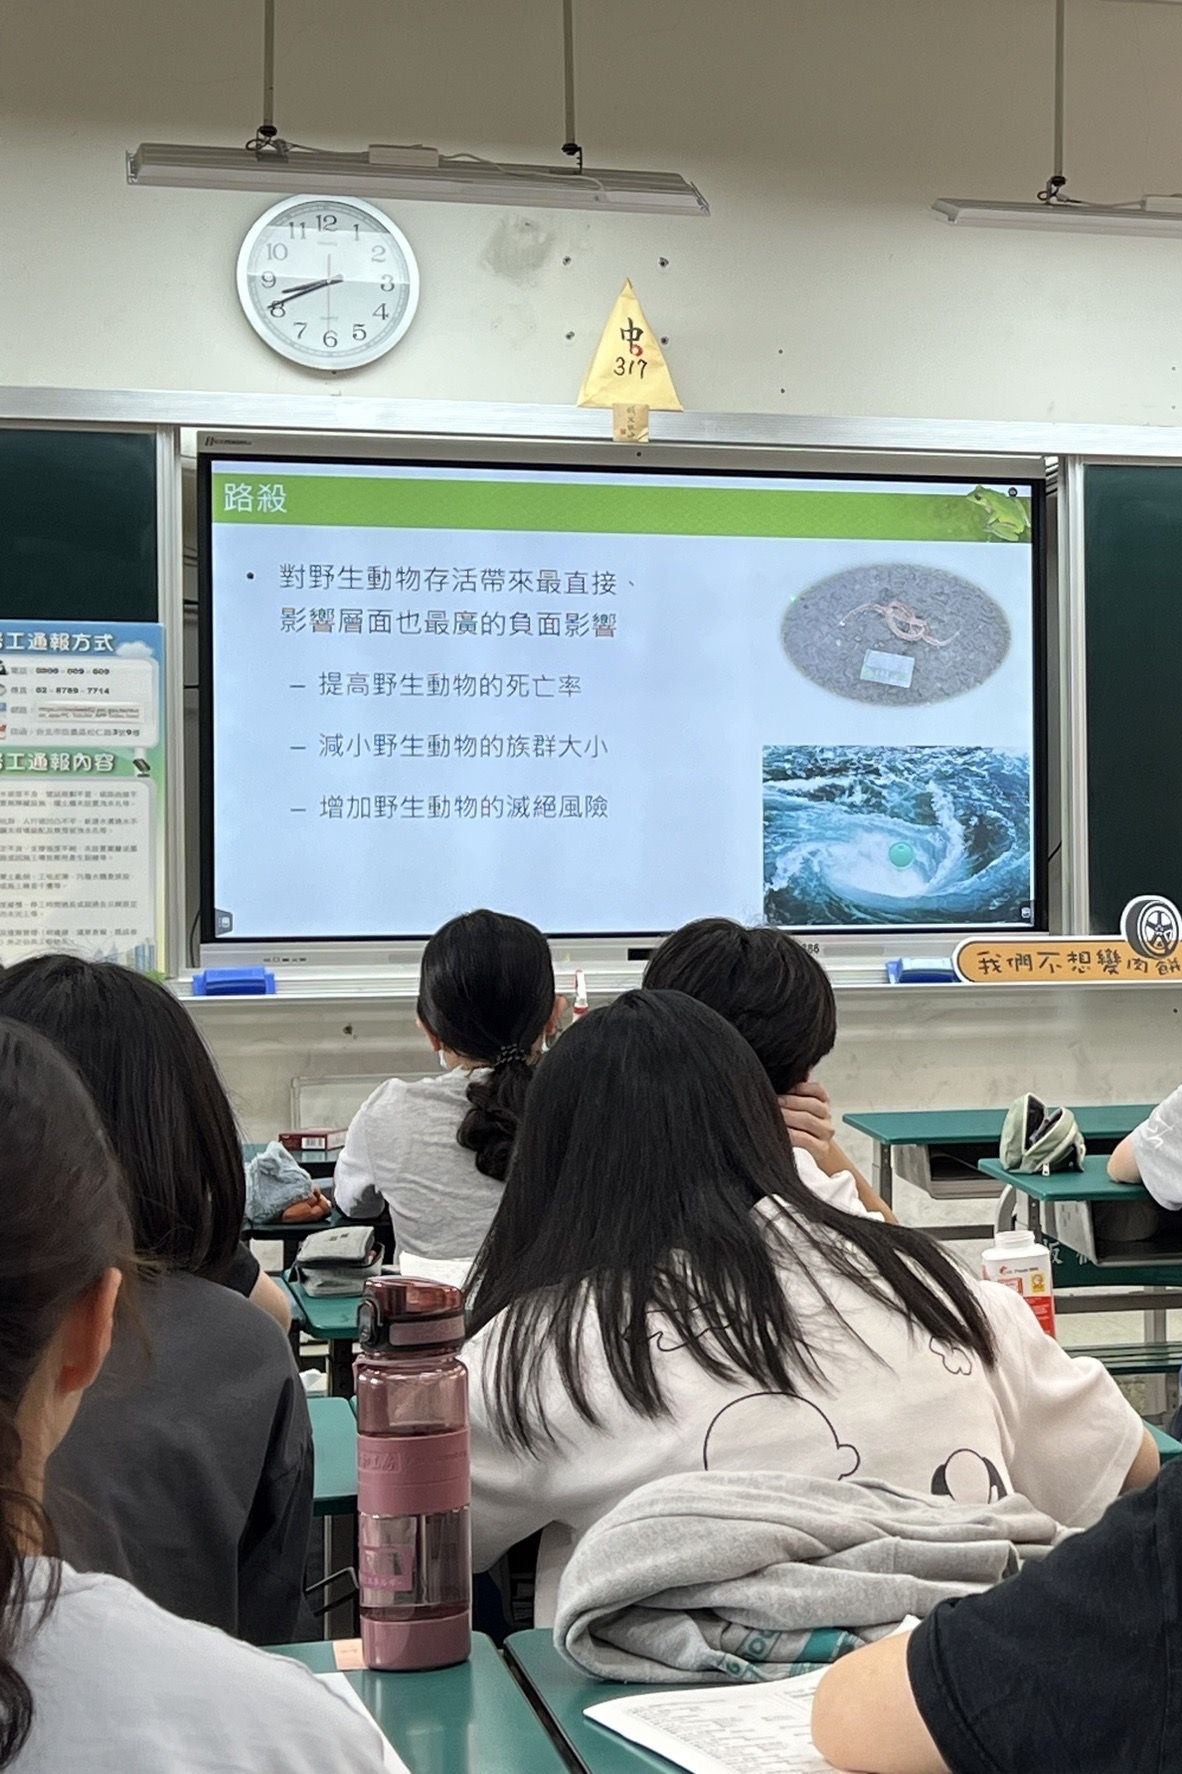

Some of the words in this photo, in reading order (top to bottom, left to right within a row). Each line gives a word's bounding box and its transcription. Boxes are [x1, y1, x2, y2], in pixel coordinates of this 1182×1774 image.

[289, 221, 306, 239] 11
[316, 214, 338, 232] 12
[353, 224, 360, 241] 1
[266, 243, 288, 261] 10
[371, 245, 386, 263] 2
[261, 271, 276, 288] 9
[380, 274, 395, 292] 3
[270, 300, 286, 318] 8
[372, 303, 389, 320] 4
[294, 322, 307, 339] 7
[323, 331, 338, 348] 6
[352, 324, 367, 341] 5
[620, 317, 644, 354] 中
[613, 356, 648, 379] 317
[223, 482, 288, 514] 路殺
[280, 606, 617, 638] 影響層面也最廣的負面影響
[318, 671, 582, 698] 提高野生動物的死亡率
[318, 733, 609, 759] 減小野生動物的族群大小
[319, 793, 609, 820] 增加野生動物的滅絕風險
[976, 948, 1181, 976] 我們不想變肉餅
